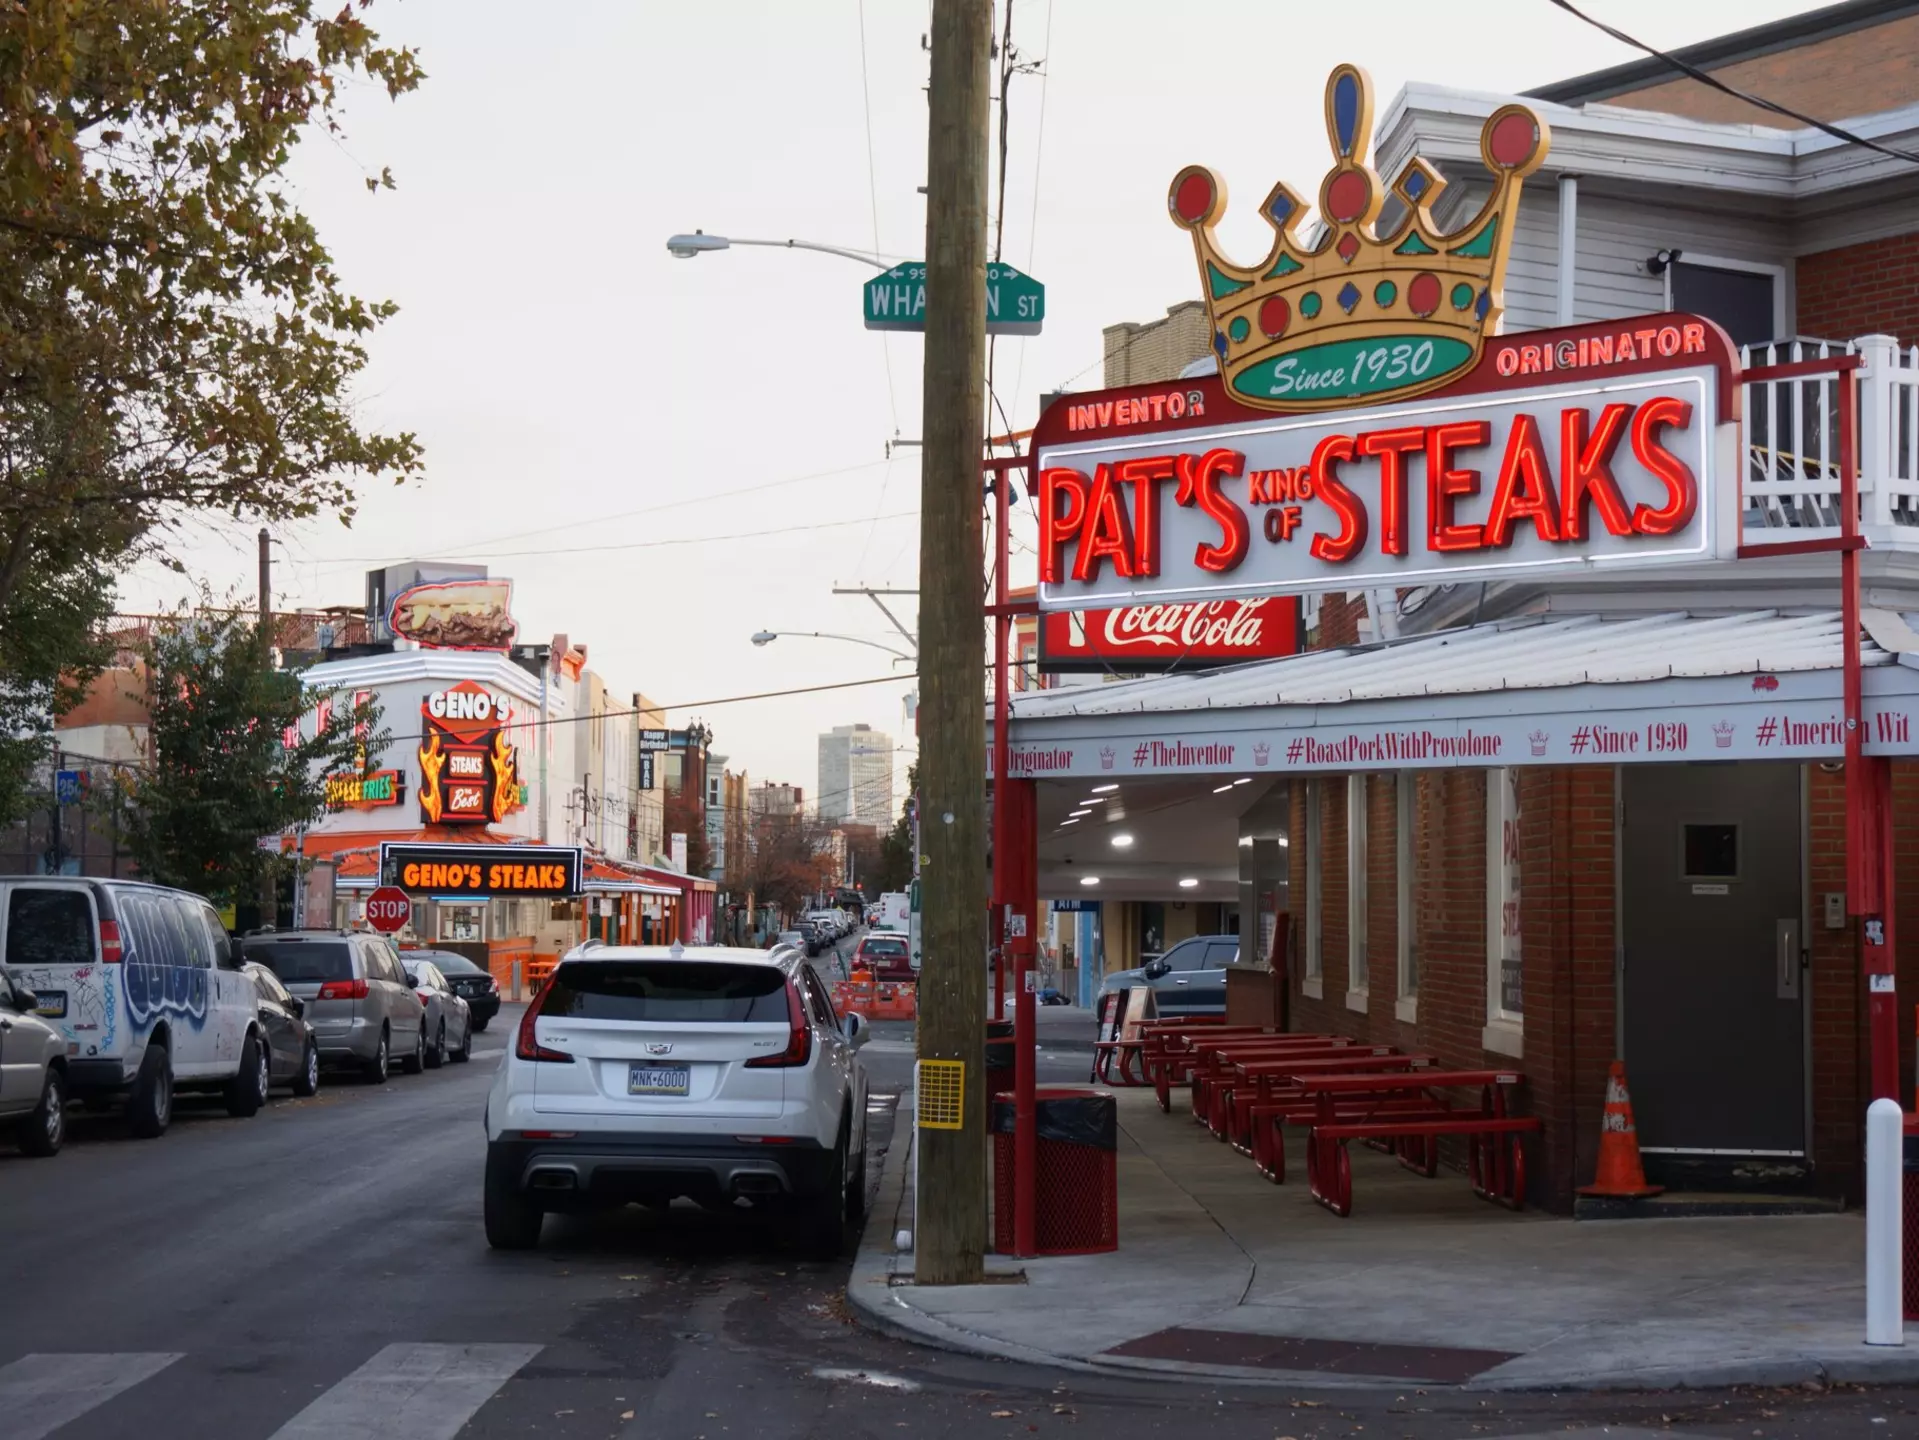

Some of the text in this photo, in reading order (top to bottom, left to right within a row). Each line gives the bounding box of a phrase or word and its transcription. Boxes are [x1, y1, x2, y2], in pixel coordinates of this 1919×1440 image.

[871, 284, 1039, 317] WHAN ST
[1496, 323, 1706, 376] ORIGINATOR
[1269, 340, 1434, 395] Since 1930
[1068, 390, 1205, 431] INVENTOR
[1040, 395, 1698, 585] PAT'S KING OF STEAKS
[1104, 596, 1264, 647] Coca-Cola
[428, 690, 511, 722] GENO'S
[640, 740, 668, 750] Birthday
[644, 731, 664, 740] Happy
[1569, 721, 1689, 755] #Since 1930
[1755, 711, 1910, 747] #Americn Wit
[1133, 740, 1235, 768] #TheInventor
[1286, 729, 1502, 764] #RoastPorkWithProvolone
[450, 755, 483, 775] STEAKS
[363, 775, 391, 801] FRIES
[450, 788, 481, 811] Best
[403, 863, 566, 889] GENO'S STEAKS
[368, 900, 408, 919] STOP
